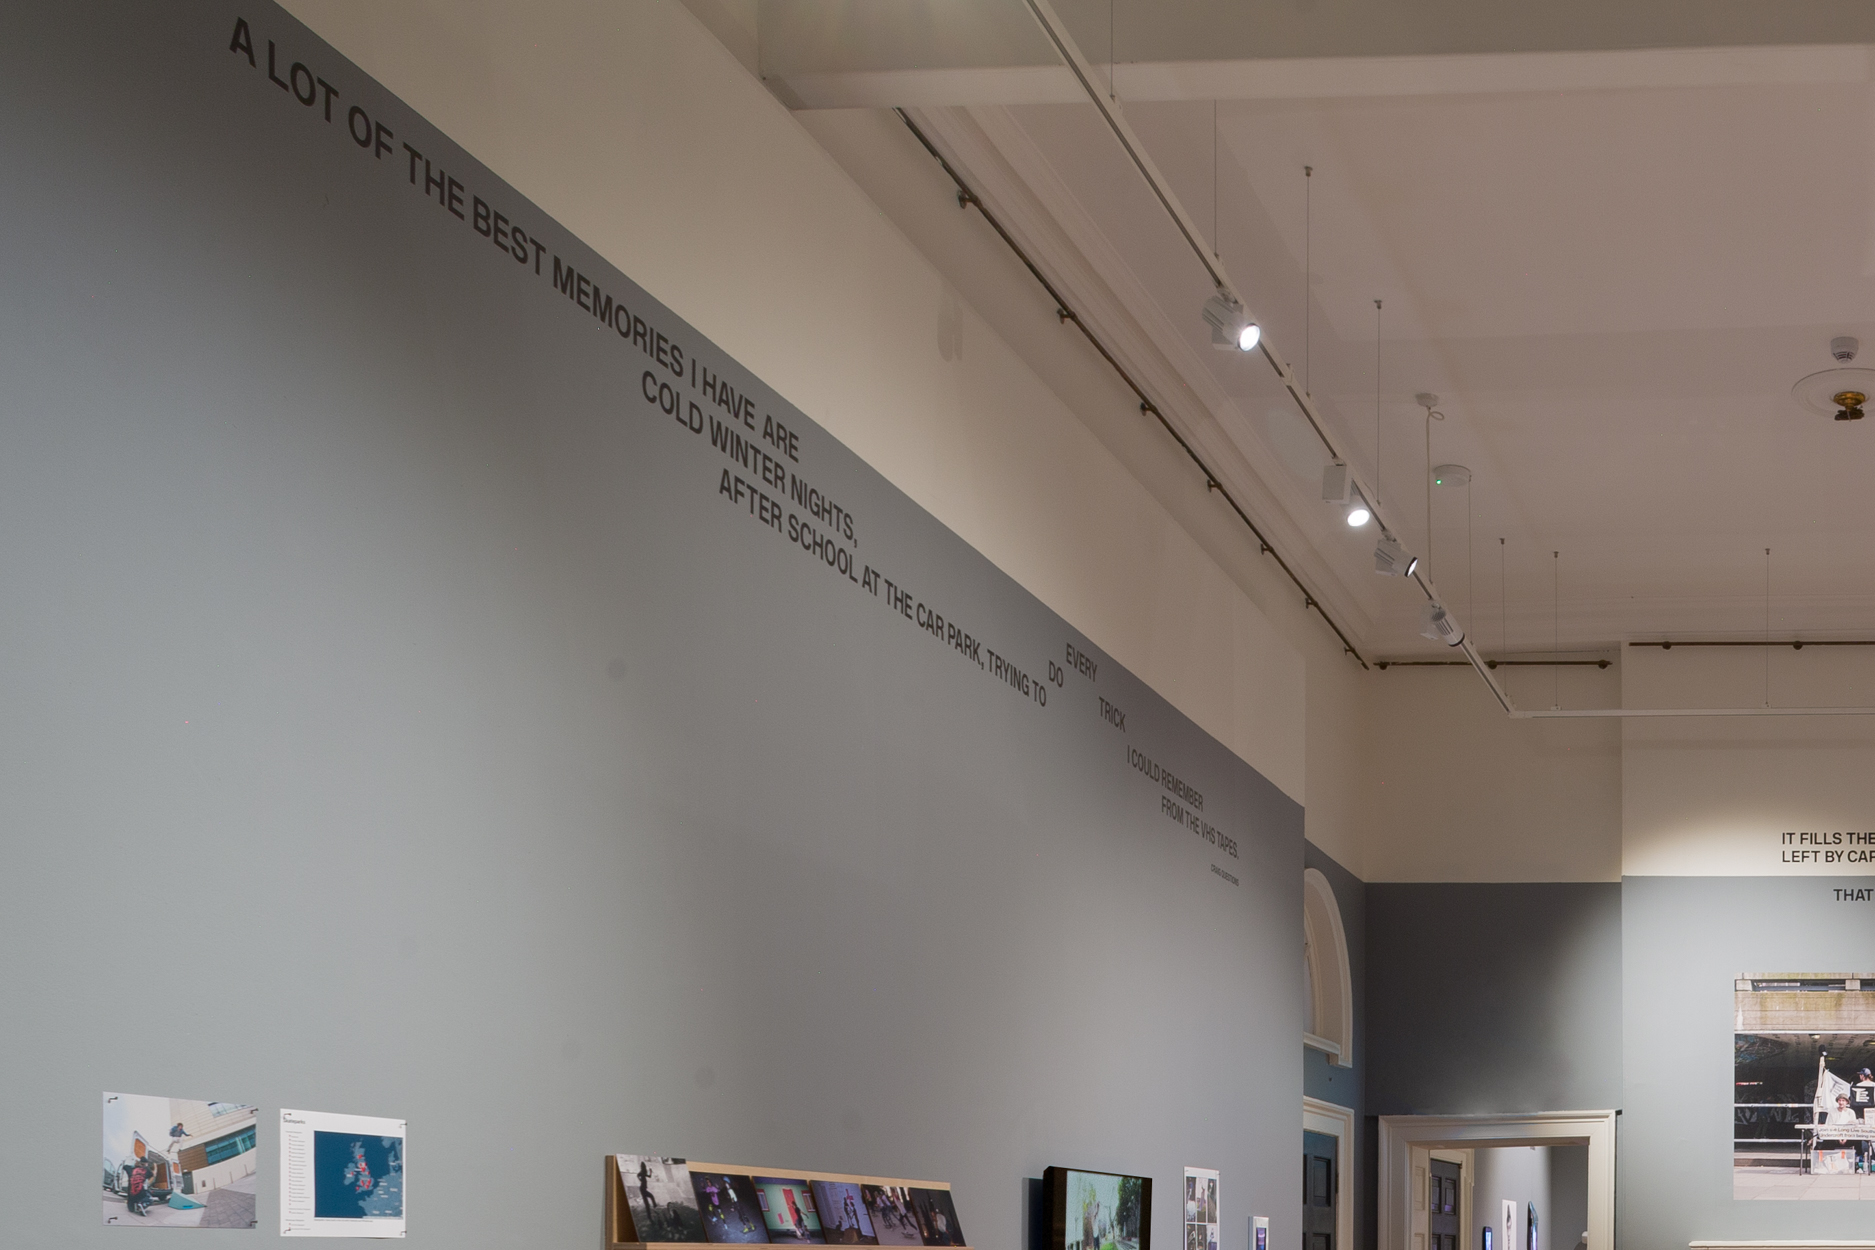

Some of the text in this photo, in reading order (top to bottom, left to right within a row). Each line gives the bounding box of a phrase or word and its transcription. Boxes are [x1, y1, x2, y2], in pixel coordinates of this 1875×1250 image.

[229, 16, 800, 464] A LOT OF THE BEST MEMORIES I HAVE ARE
[641, 370, 859, 549] COLD WINTER NIGHTS,
[718, 468, 1048, 708] AFTER SCHOOL AT THE CAR PARK, TRYING TO
[1047, 660, 1064, 689] DO
[1065, 642, 1098, 683] EVERY
[1098, 696, 1127, 734] TRICK
[1131, 748, 1161, 783] COULD
[1161, 768, 1204, 812] REMEMBER
[1161, 794, 1240, 860] FROM THE VHS TAPES.
[1781, 833, 1796, 845] IT
[1799, 832, 1843, 845] FILLS
[1781, 850, 1821, 863] LEFT
[1823, 850, 1844, 863] BY
[1833, 889, 1875, 902] THAT
